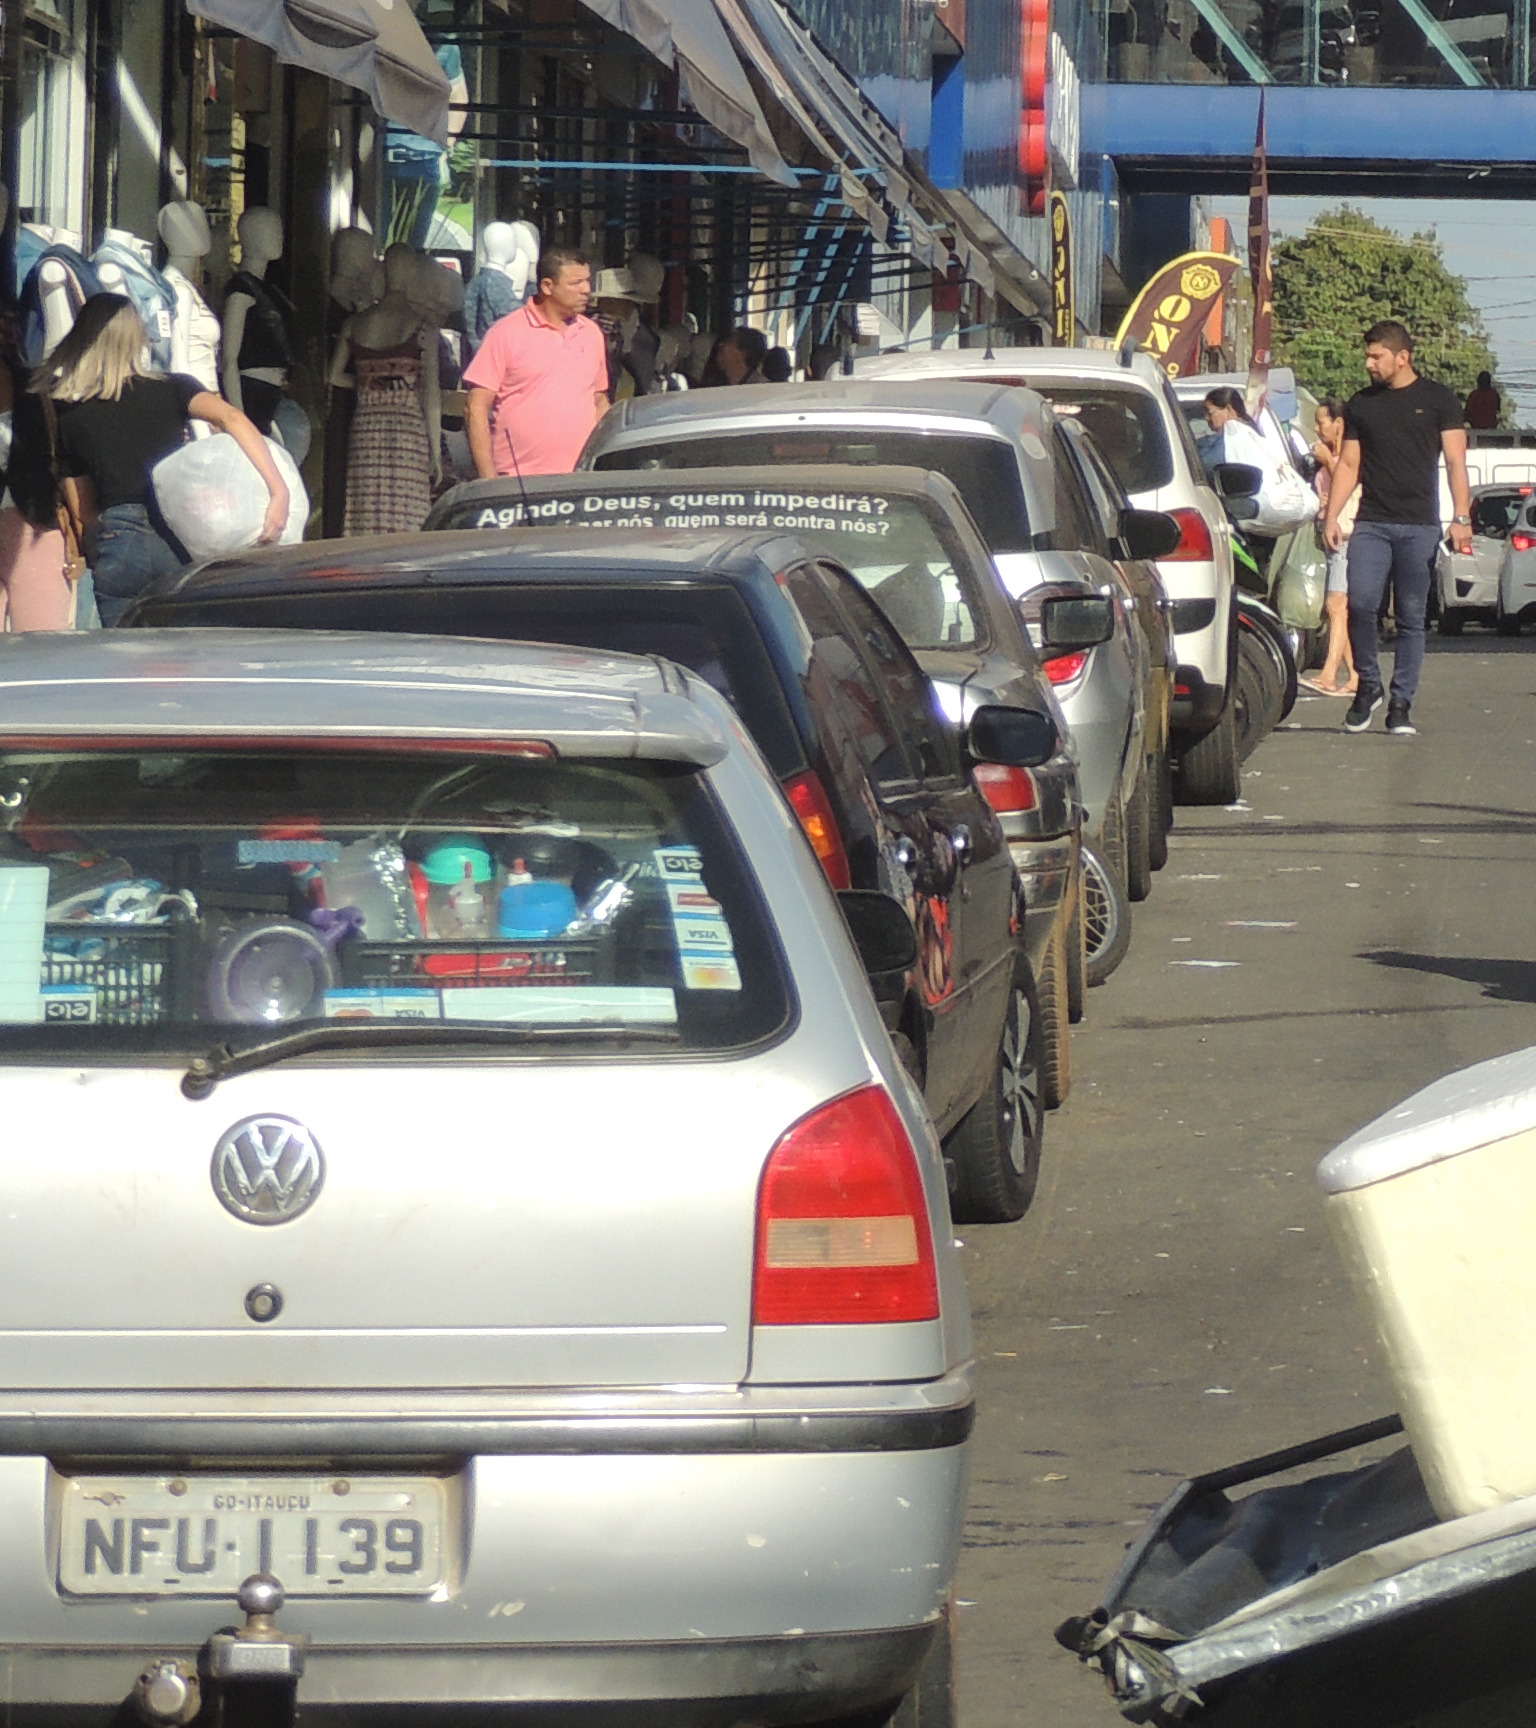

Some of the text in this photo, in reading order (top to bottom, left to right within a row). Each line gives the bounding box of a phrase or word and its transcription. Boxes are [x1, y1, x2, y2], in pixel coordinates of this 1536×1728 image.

[476, 489, 890, 529] Agindo Deus, quem impedirá?
[725, 510, 768, 528] será
[773, 515, 836, 531] contra
[841, 518, 891, 537] nós?
